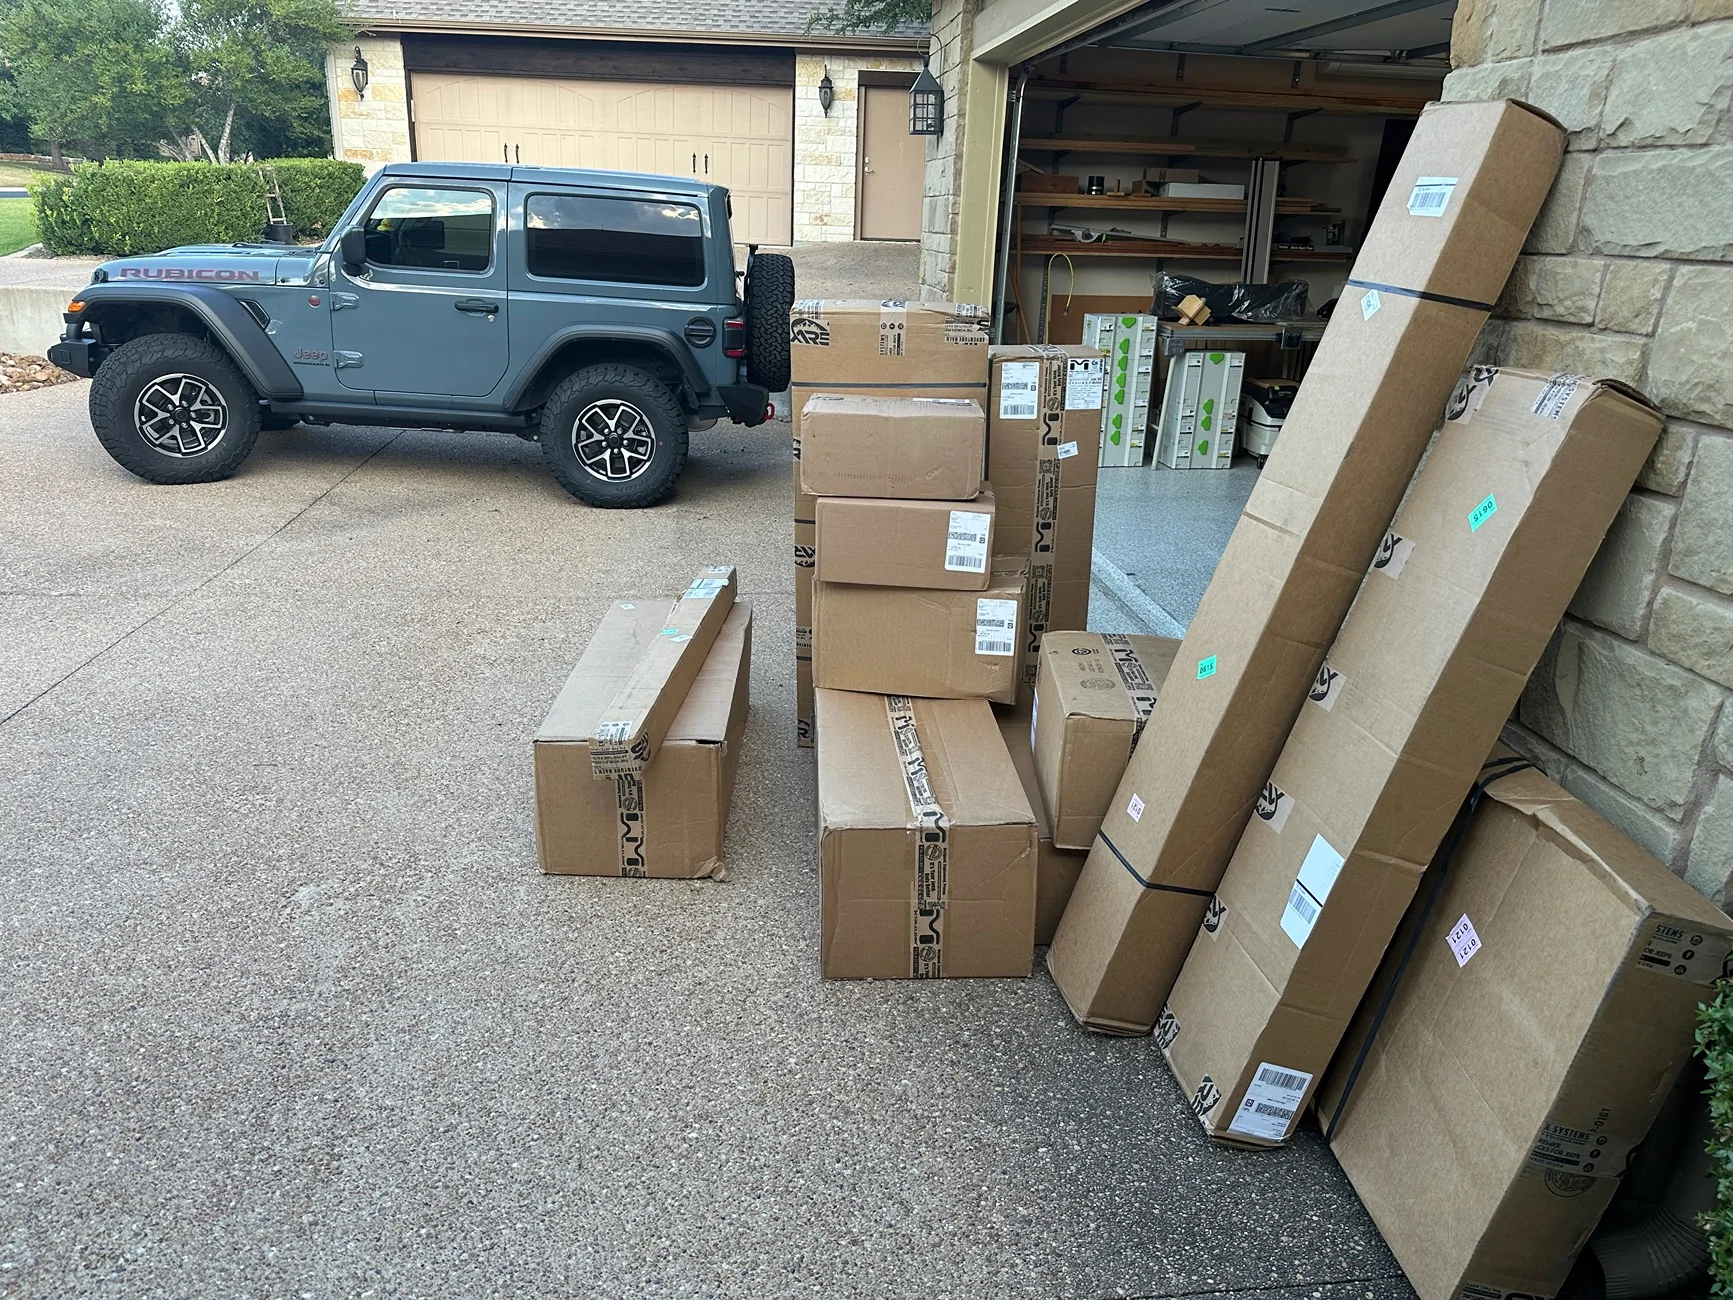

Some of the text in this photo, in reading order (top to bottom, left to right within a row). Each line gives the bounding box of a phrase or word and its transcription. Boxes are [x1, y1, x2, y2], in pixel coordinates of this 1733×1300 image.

[120, 267, 260, 281] RUBICON
[293, 346, 328, 362] Jeep
[1473, 501, 1493, 522] 0615
[1199, 663, 1214, 674] 0615
[1131, 801, 1142, 815] 0121
[1452, 923, 1469, 944] 0121
[1460, 938, 1476, 959] 0121
[1552, 1125, 1590, 1141] SYSTEMS
